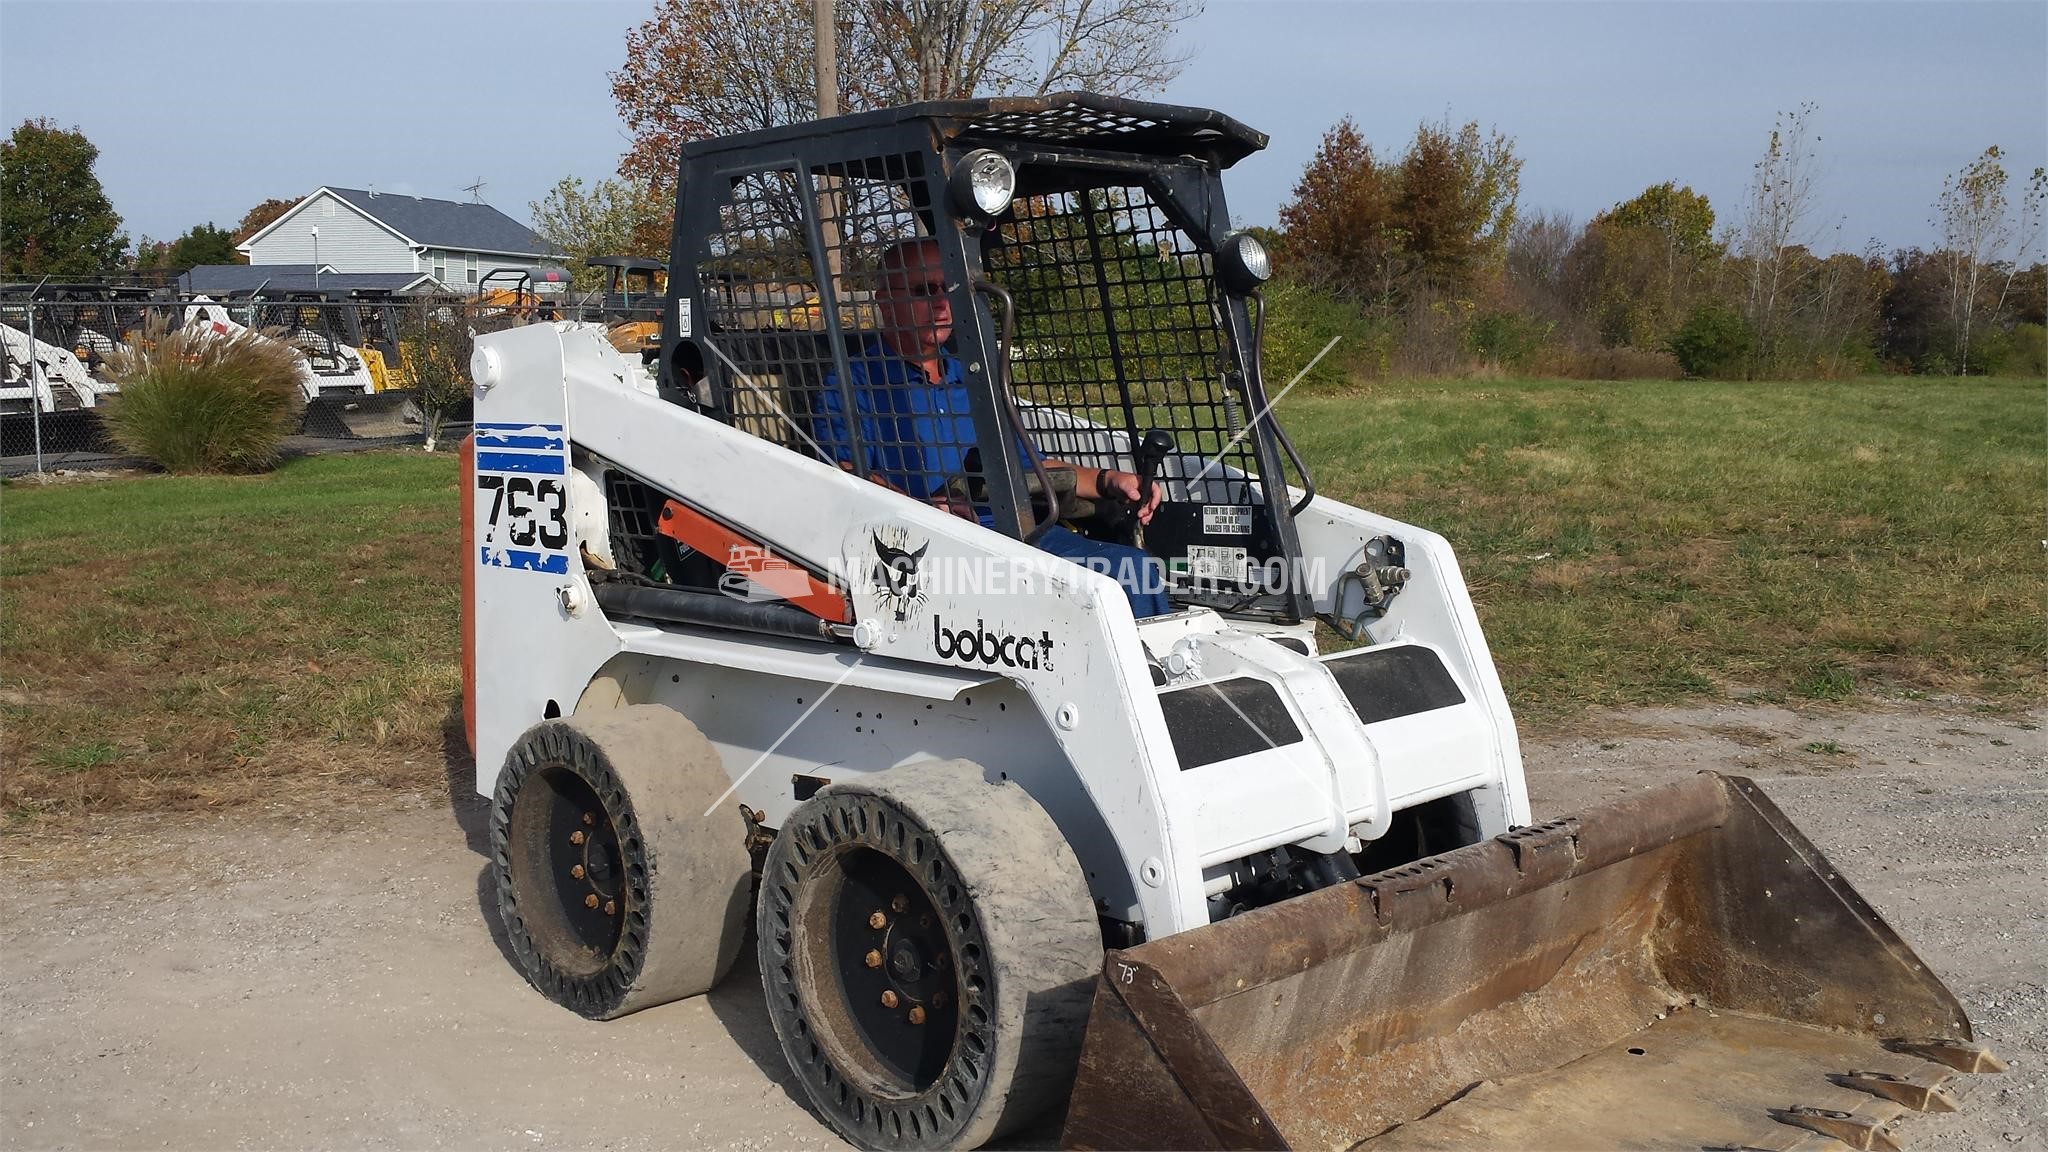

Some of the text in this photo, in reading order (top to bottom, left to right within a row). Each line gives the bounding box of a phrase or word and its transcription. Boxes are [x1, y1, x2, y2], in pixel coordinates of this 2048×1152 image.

[478, 475, 568, 550] 763
[1204, 507, 1251, 515] RETURN THIS EQUIPMENT
[1215, 516, 1240, 524] CLEAN OR BE
[1222, 525, 1230, 533] FOR
[1231, 525, 1250, 533] CLEANING
[934, 614, 1054, 672] bobcat
